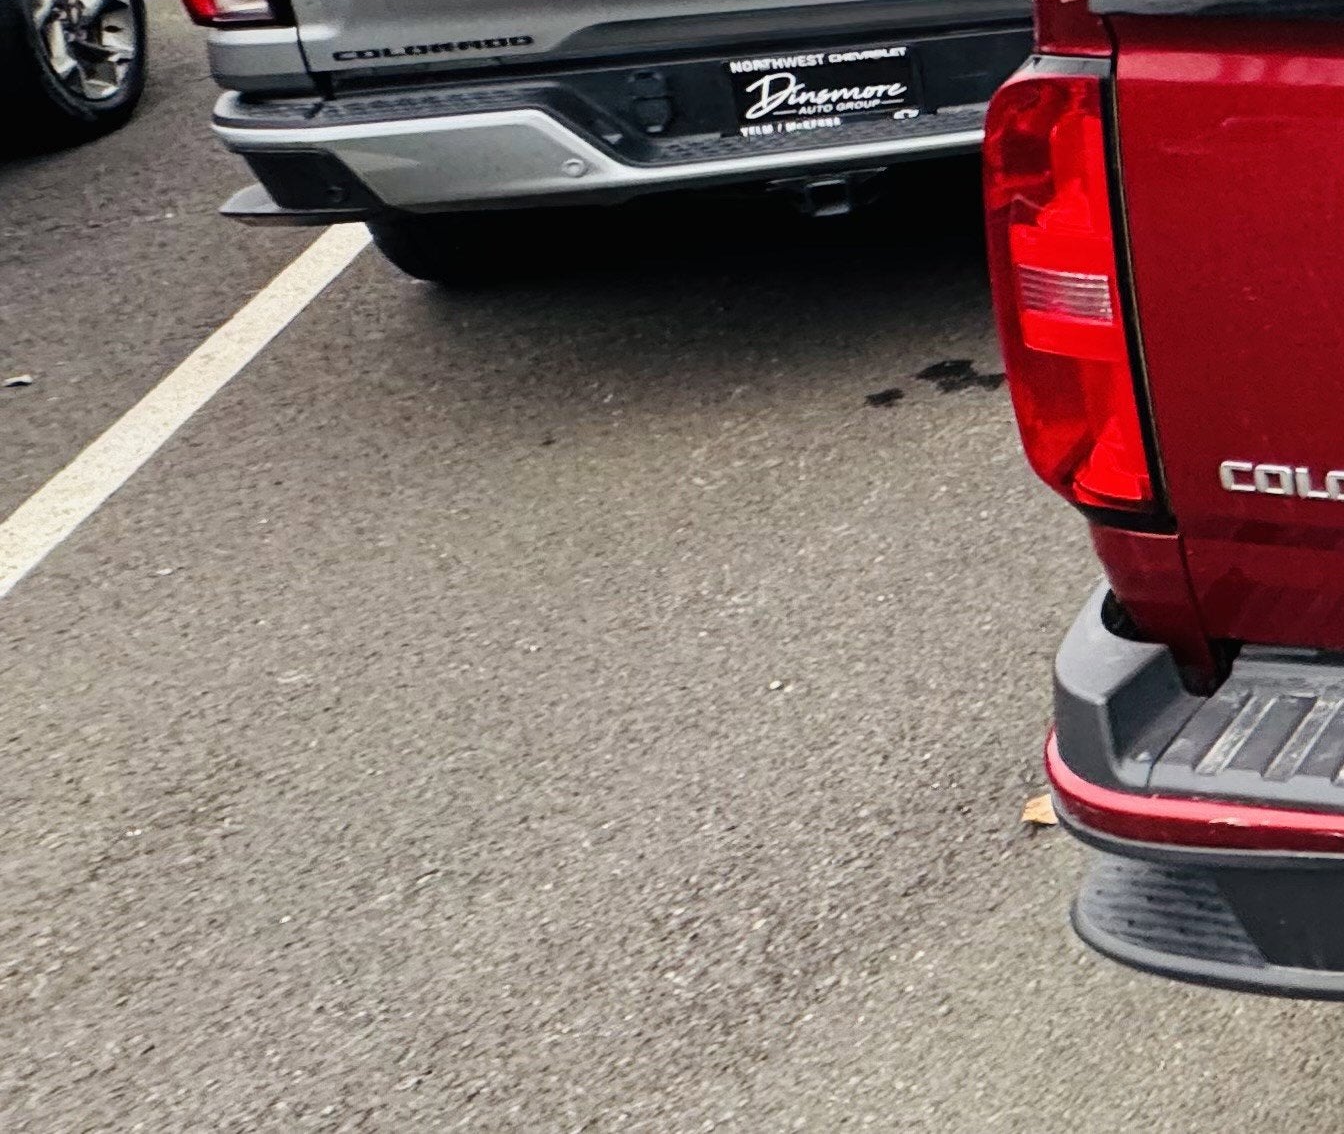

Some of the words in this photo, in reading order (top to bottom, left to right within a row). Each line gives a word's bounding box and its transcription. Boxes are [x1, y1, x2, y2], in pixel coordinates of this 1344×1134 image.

[332, 35, 535, 61] COLORADO
[730, 53, 825, 74] NORTHWEST
[828, 46, 907, 64] CHEVROLET
[745, 72, 908, 119] Dinsmore
[798, 103, 833, 115] AUTO
[835, 99, 882, 112] GROUP
